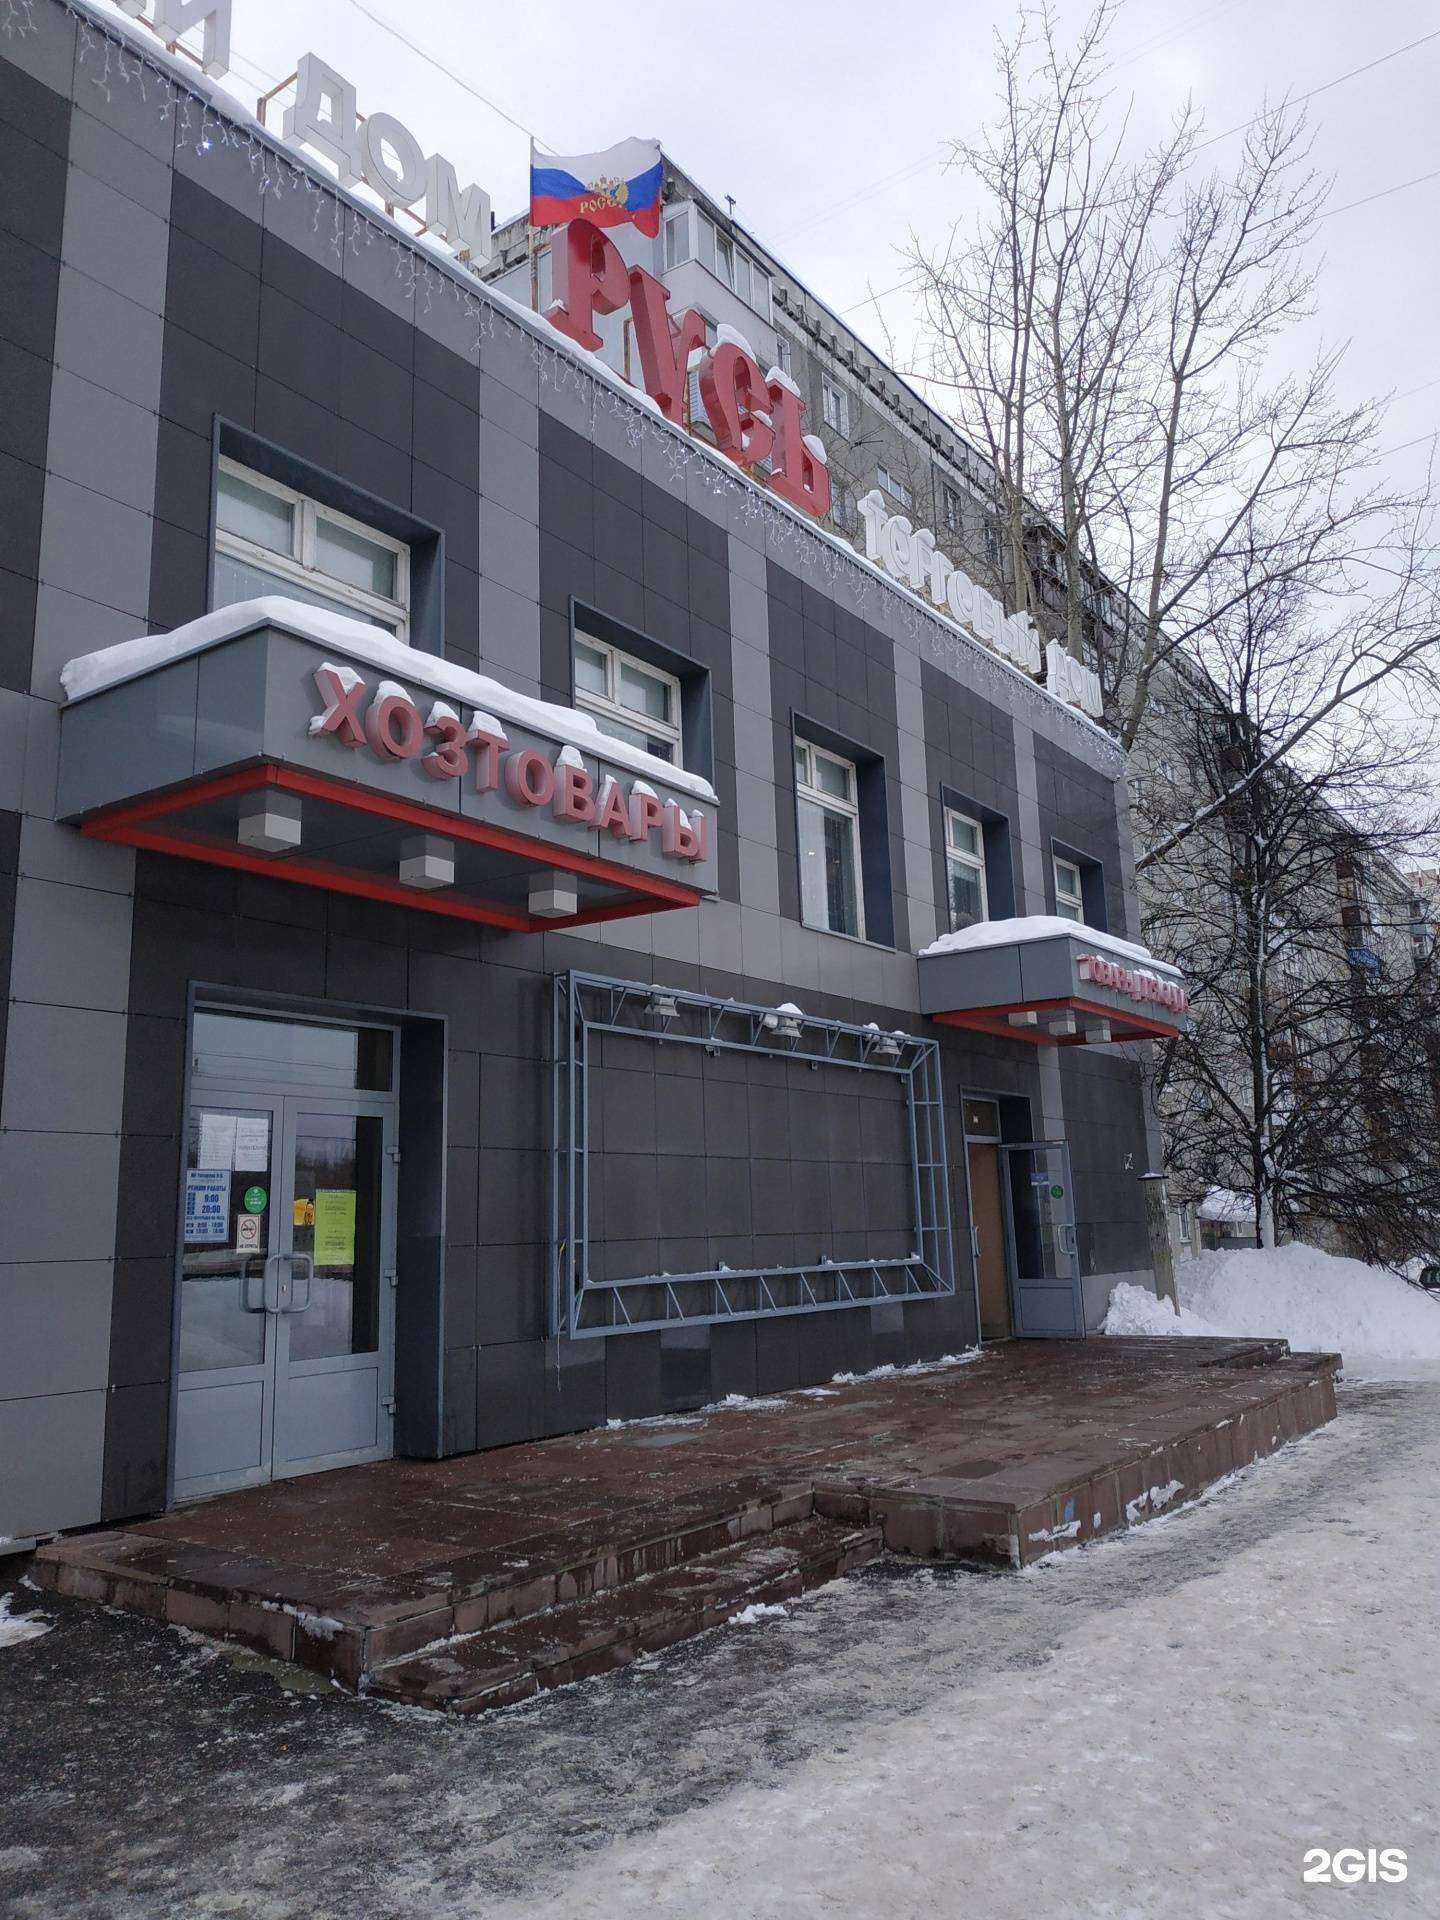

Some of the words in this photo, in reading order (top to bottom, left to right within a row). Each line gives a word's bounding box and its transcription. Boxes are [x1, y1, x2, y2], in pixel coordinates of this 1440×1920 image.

[282, 52, 492, 272] ДОМ
[543, 218, 831, 517] РУСЬ
[308, 663, 708, 864] ХОЗТОВАРЫ
